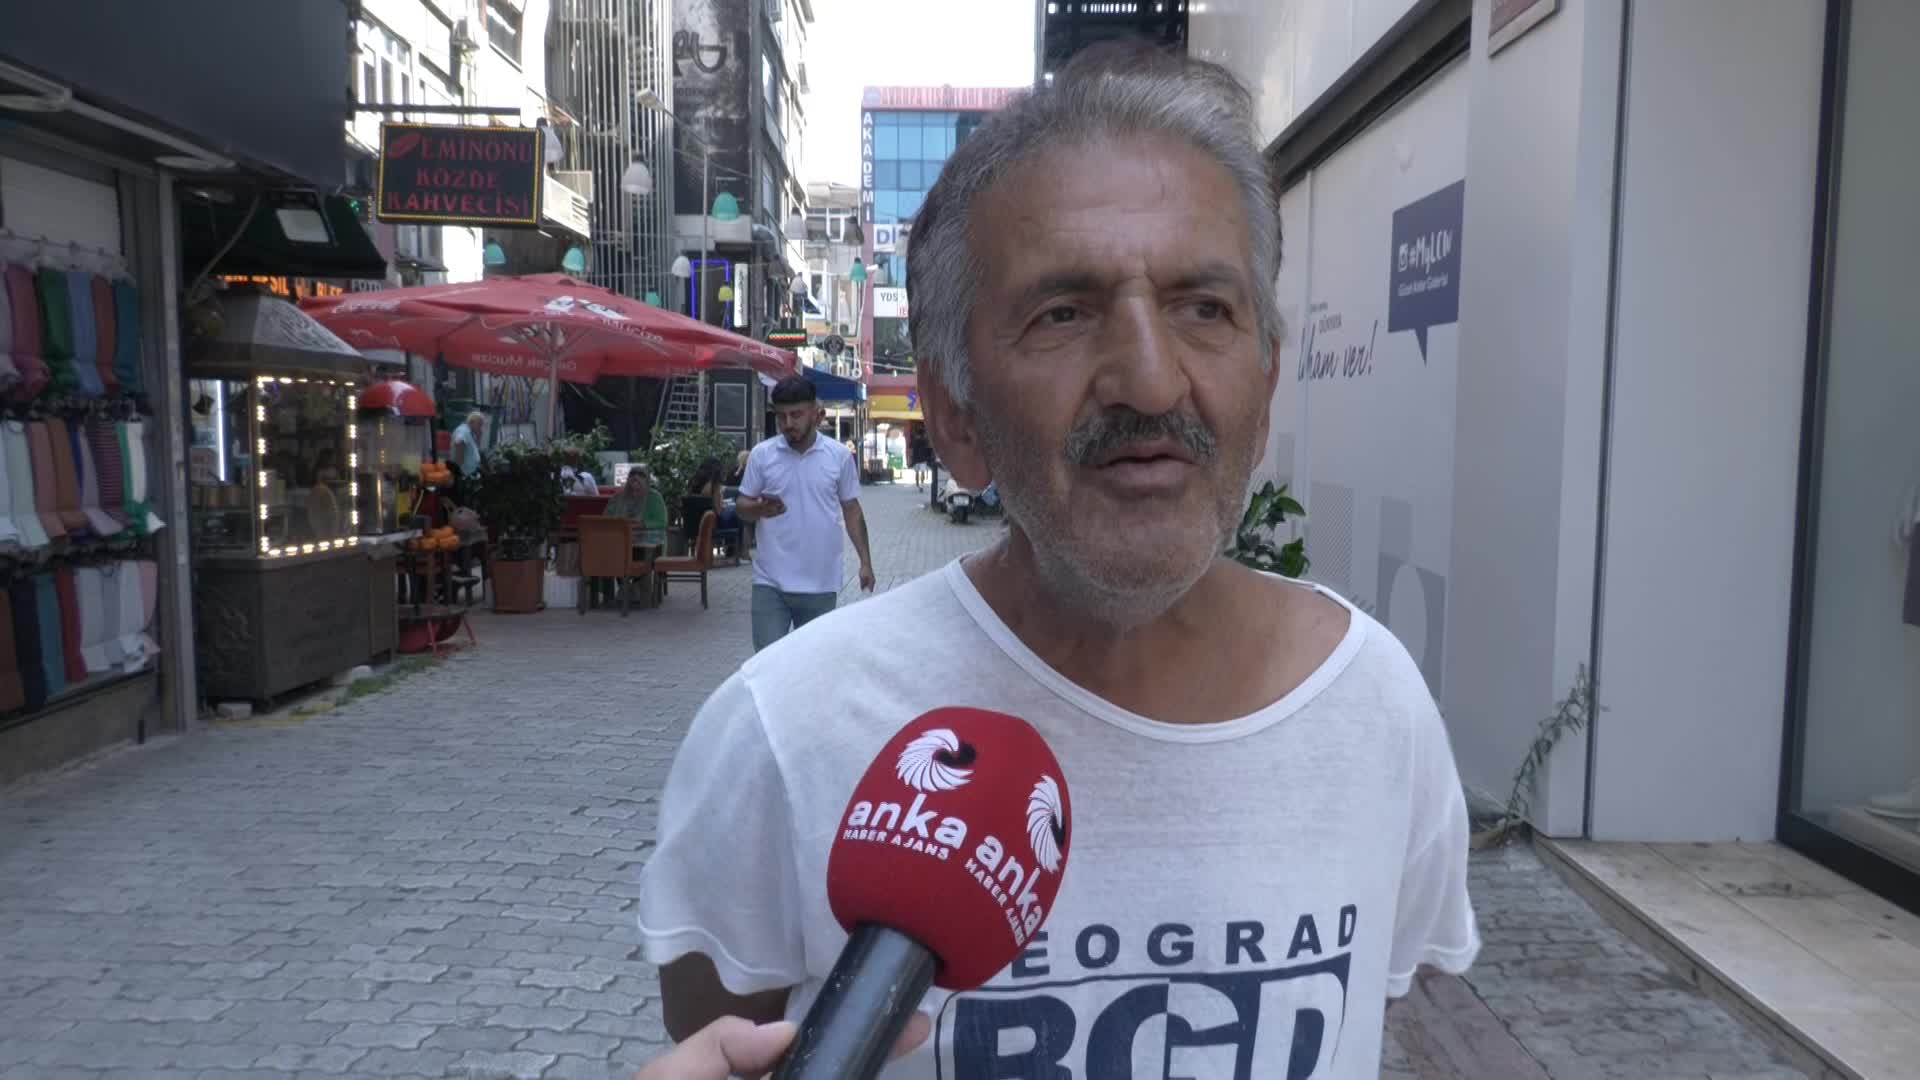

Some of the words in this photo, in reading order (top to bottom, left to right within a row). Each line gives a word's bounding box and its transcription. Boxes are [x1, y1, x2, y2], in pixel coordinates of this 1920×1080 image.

[843, 829, 887, 841] HABER
[891, 834, 949, 861] AJANS
[847, 793, 967, 849] anka
[964, 858, 1008, 907] HABER
[976, 836, 1043, 937] anka
[1011, 904, 1357, 979] EOGRAD
